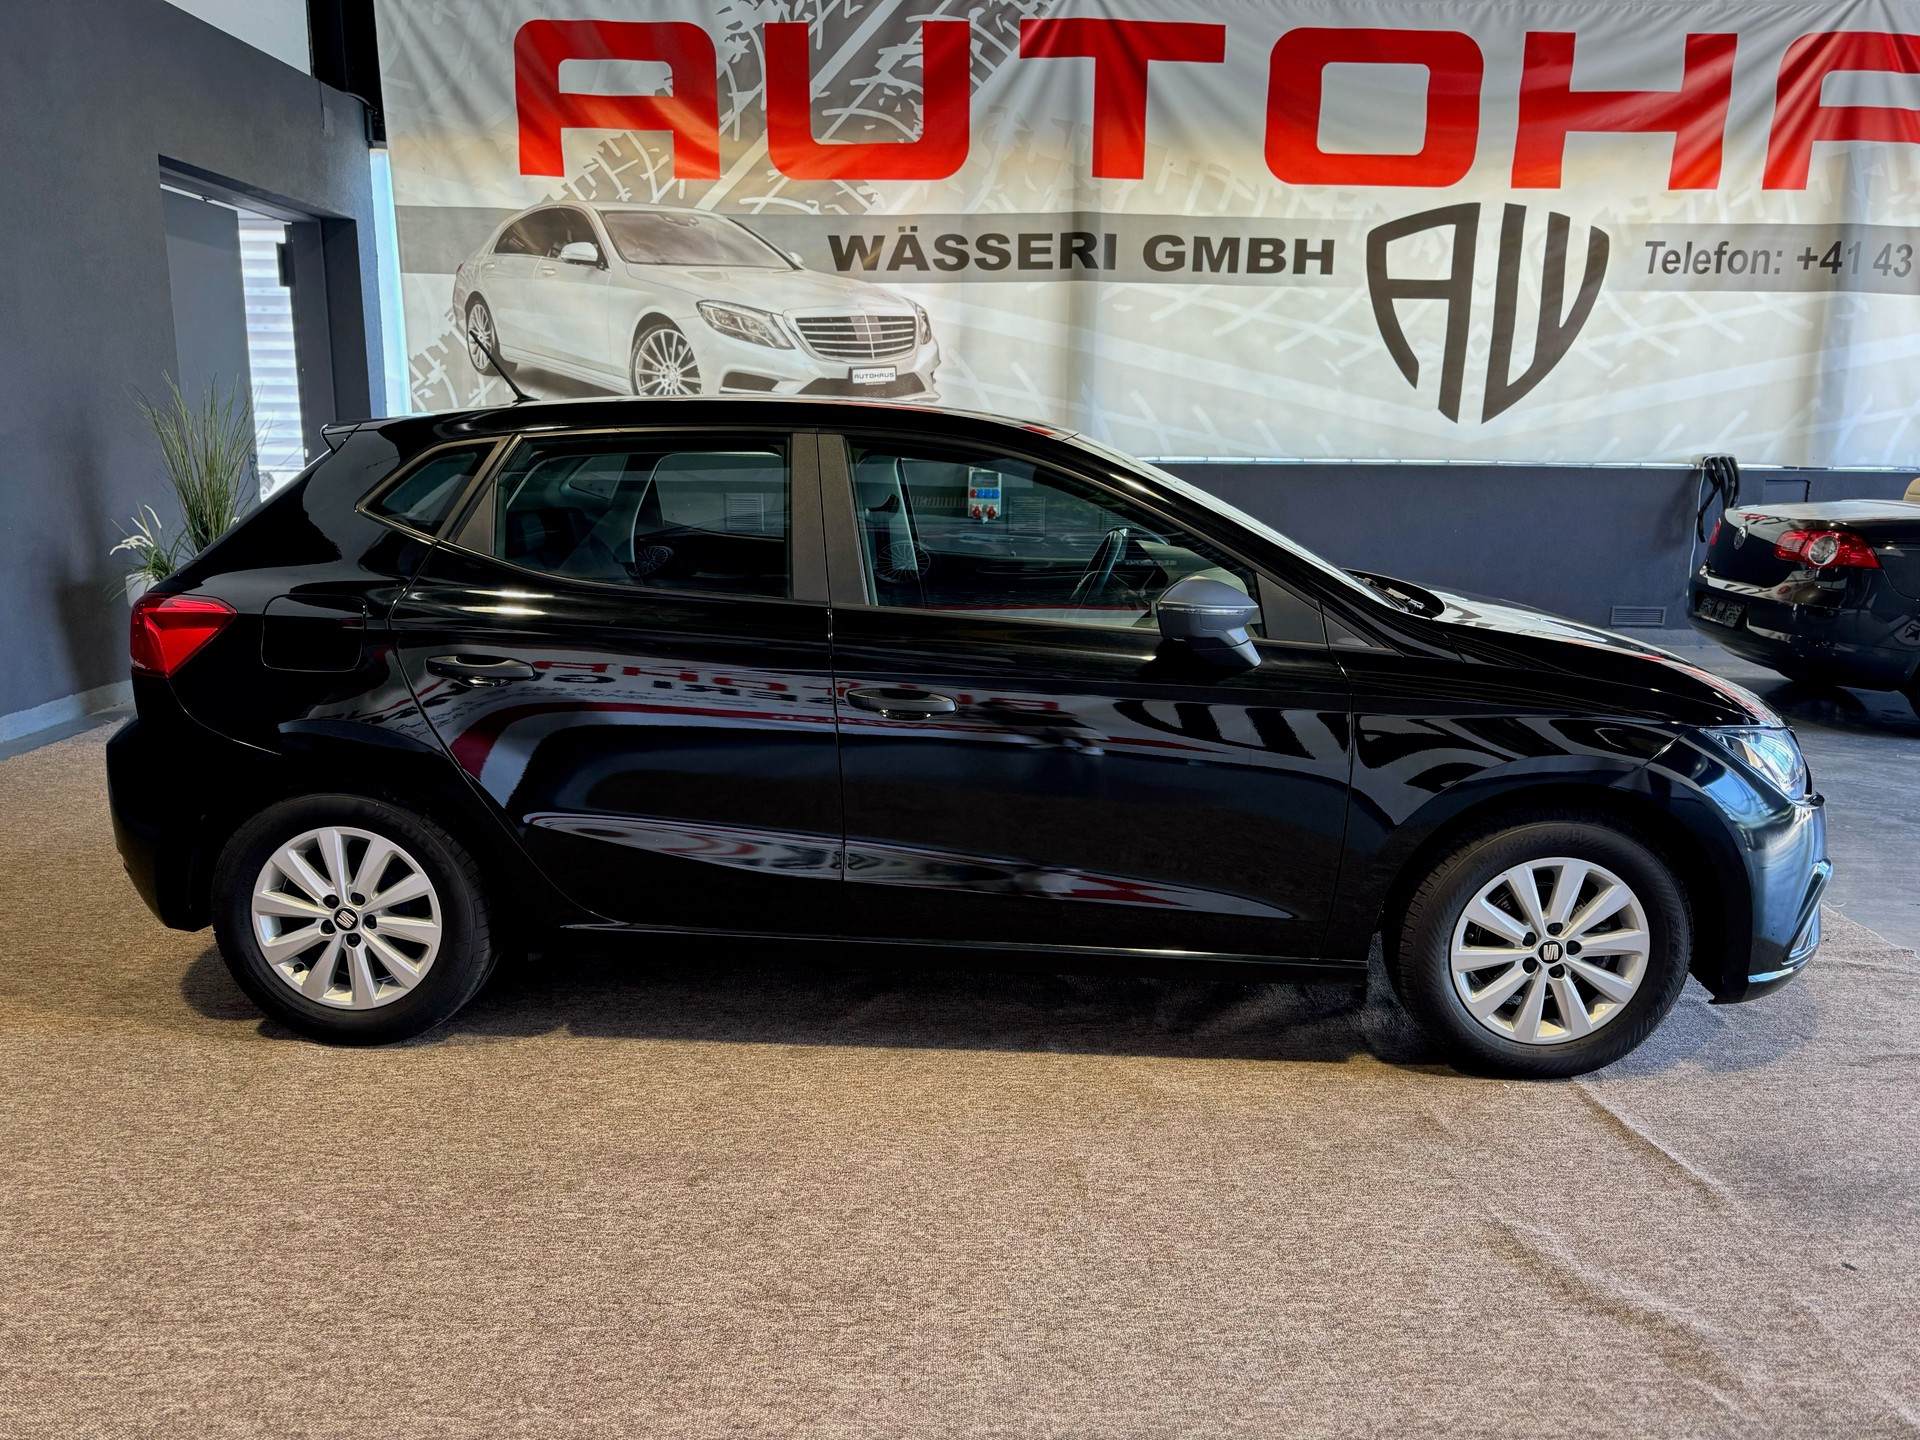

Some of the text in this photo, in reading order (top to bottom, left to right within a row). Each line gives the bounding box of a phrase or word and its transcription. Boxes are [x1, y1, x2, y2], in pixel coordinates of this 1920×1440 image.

[513, 18, 1920, 191] AUTOHA
[827, 225, 1335, 275] WÄSSERI GMBH
[1645, 240, 1914, 278] Telefon: +41 43
